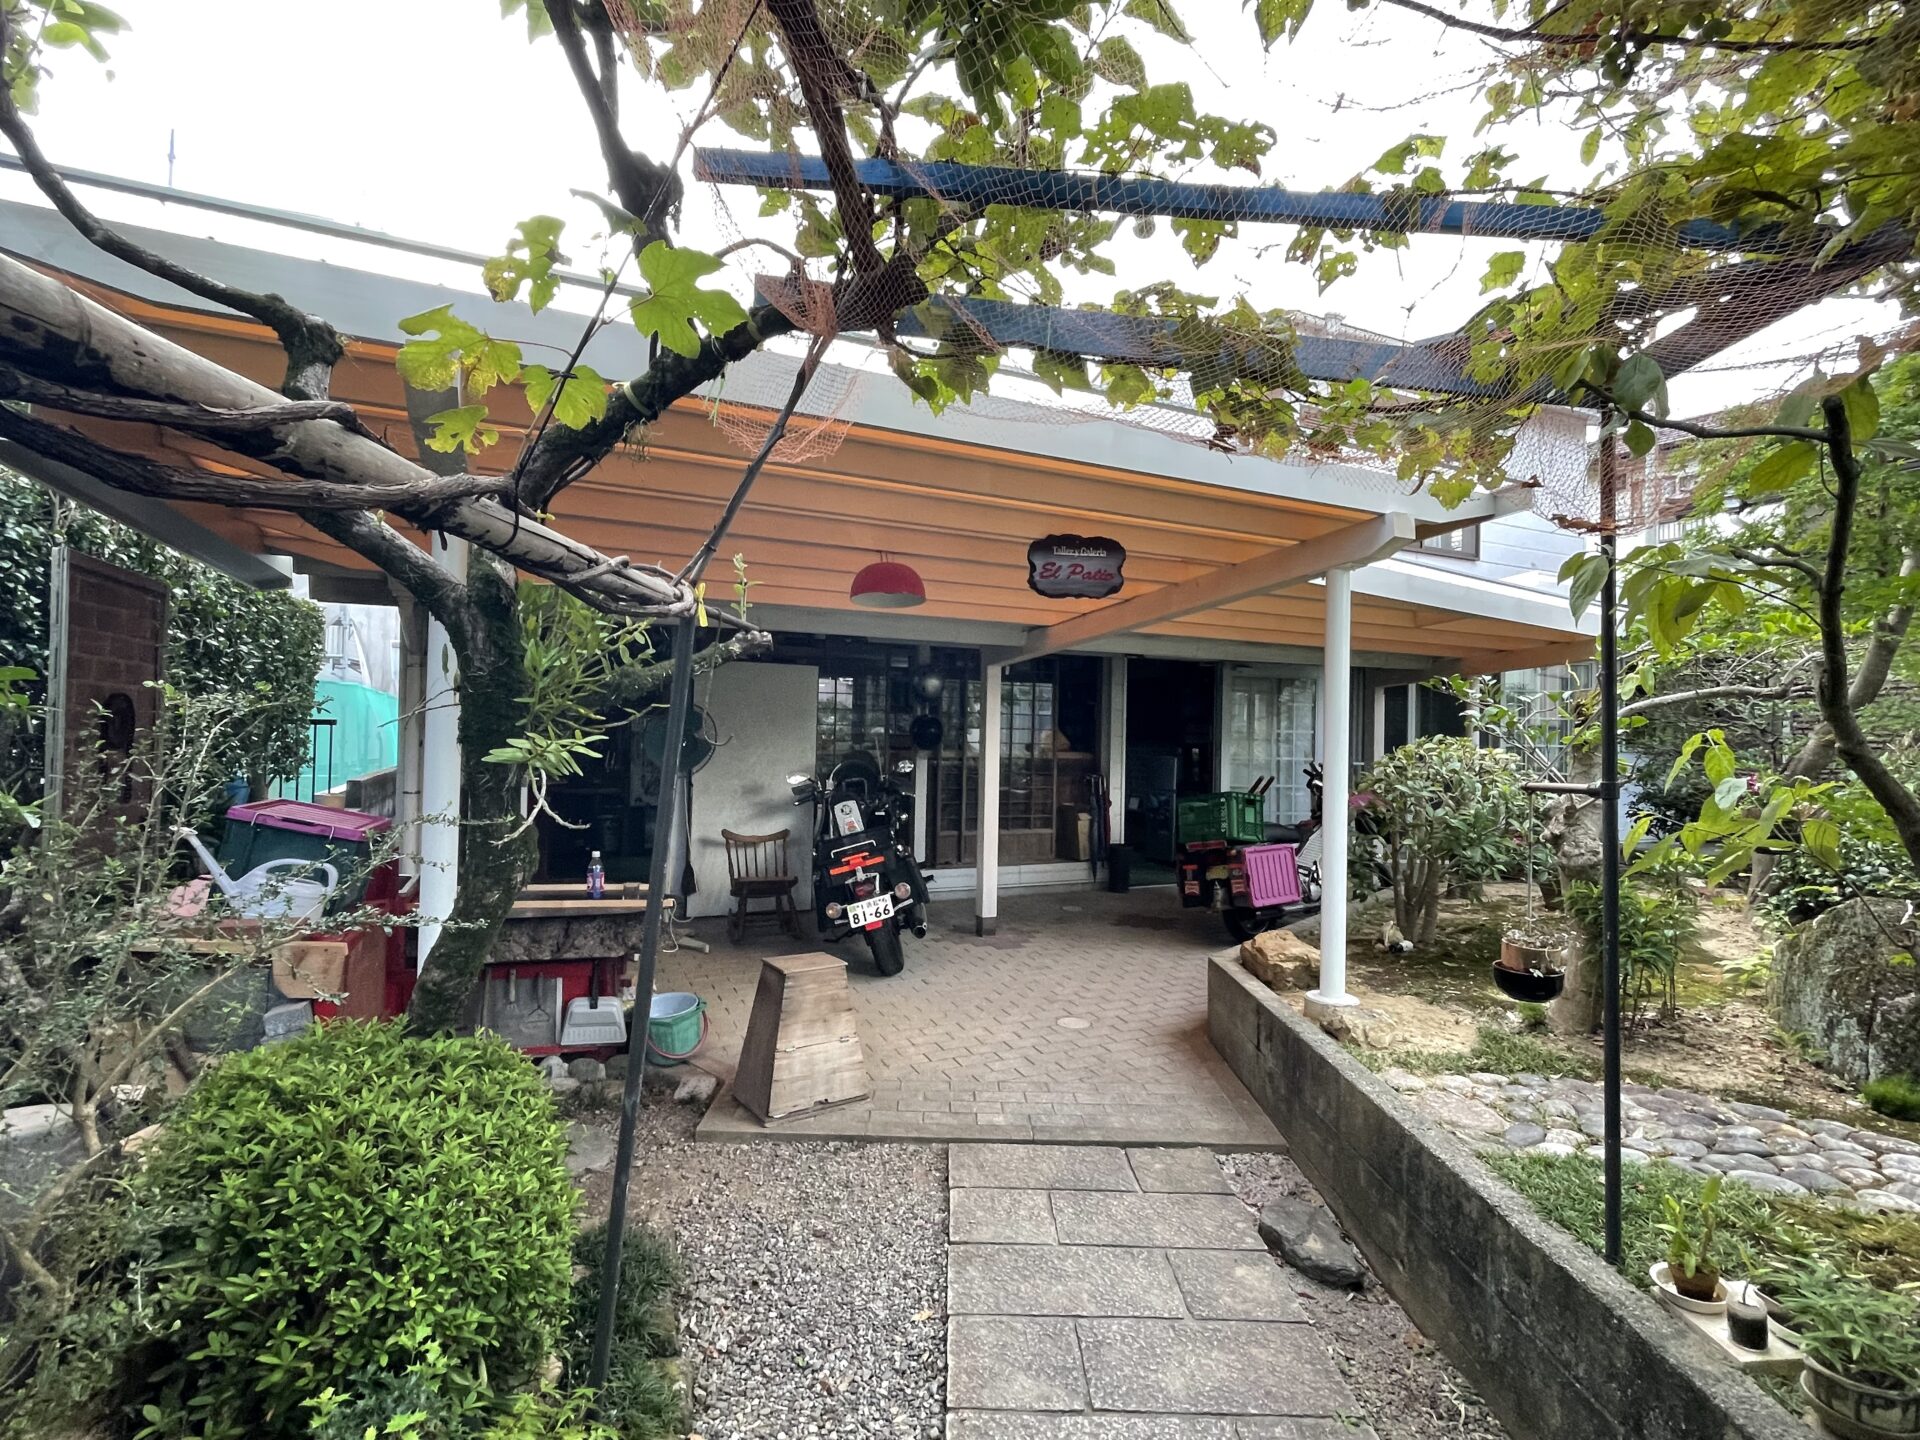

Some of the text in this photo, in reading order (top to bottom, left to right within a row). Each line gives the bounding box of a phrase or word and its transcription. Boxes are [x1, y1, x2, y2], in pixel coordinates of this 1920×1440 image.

[1039, 561, 1115, 581] El Patio
[852, 904, 890, 924] 81-66
